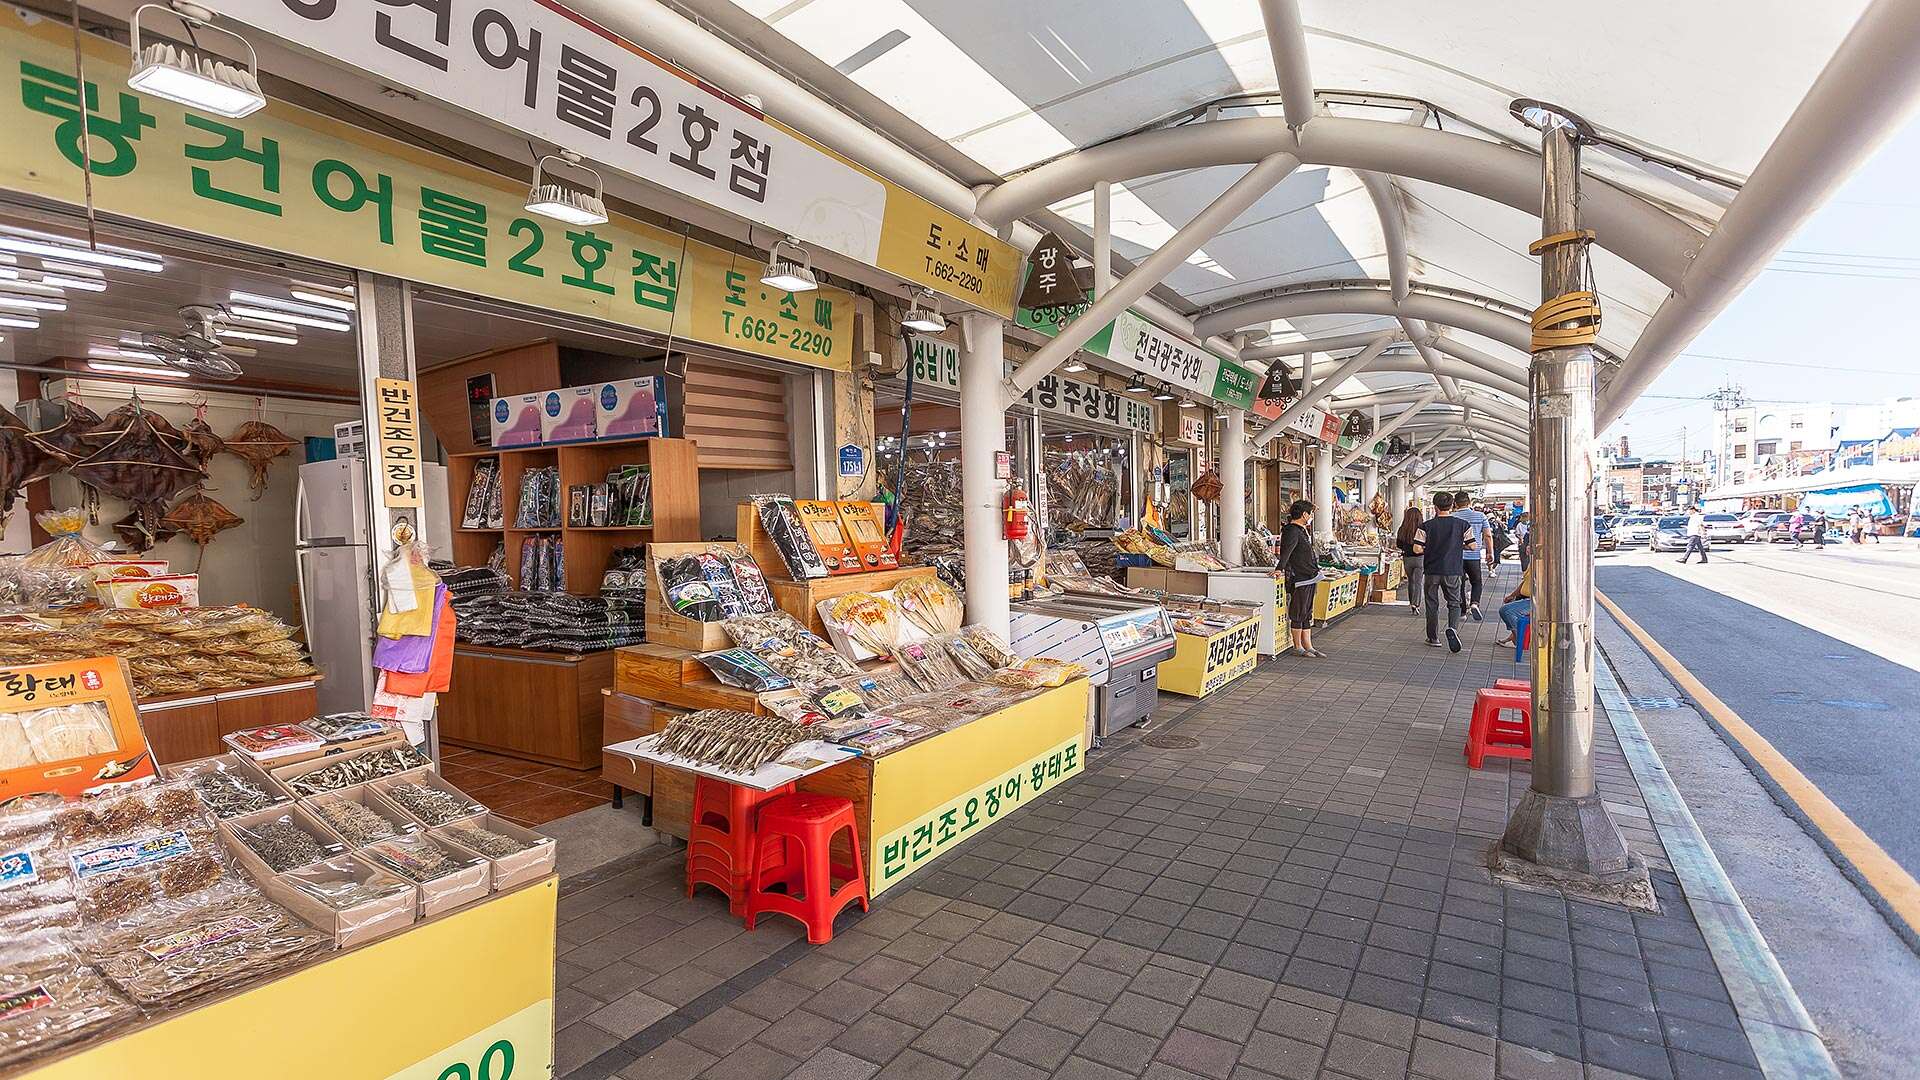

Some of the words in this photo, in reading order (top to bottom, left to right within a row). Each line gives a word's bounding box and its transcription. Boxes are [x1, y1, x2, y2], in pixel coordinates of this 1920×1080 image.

[281, 0, 771, 203] 건어물2호점
[925, 255, 983, 294] T.662-2290
[1039, 247, 1058, 293] 광주
[721, 310, 833, 357] T.662-2290
[1134, 330, 1203, 383] 전라광주상회
[1022, 374, 1121, 424] 광주상회
[382, 387, 417, 499] 반건조오징어
